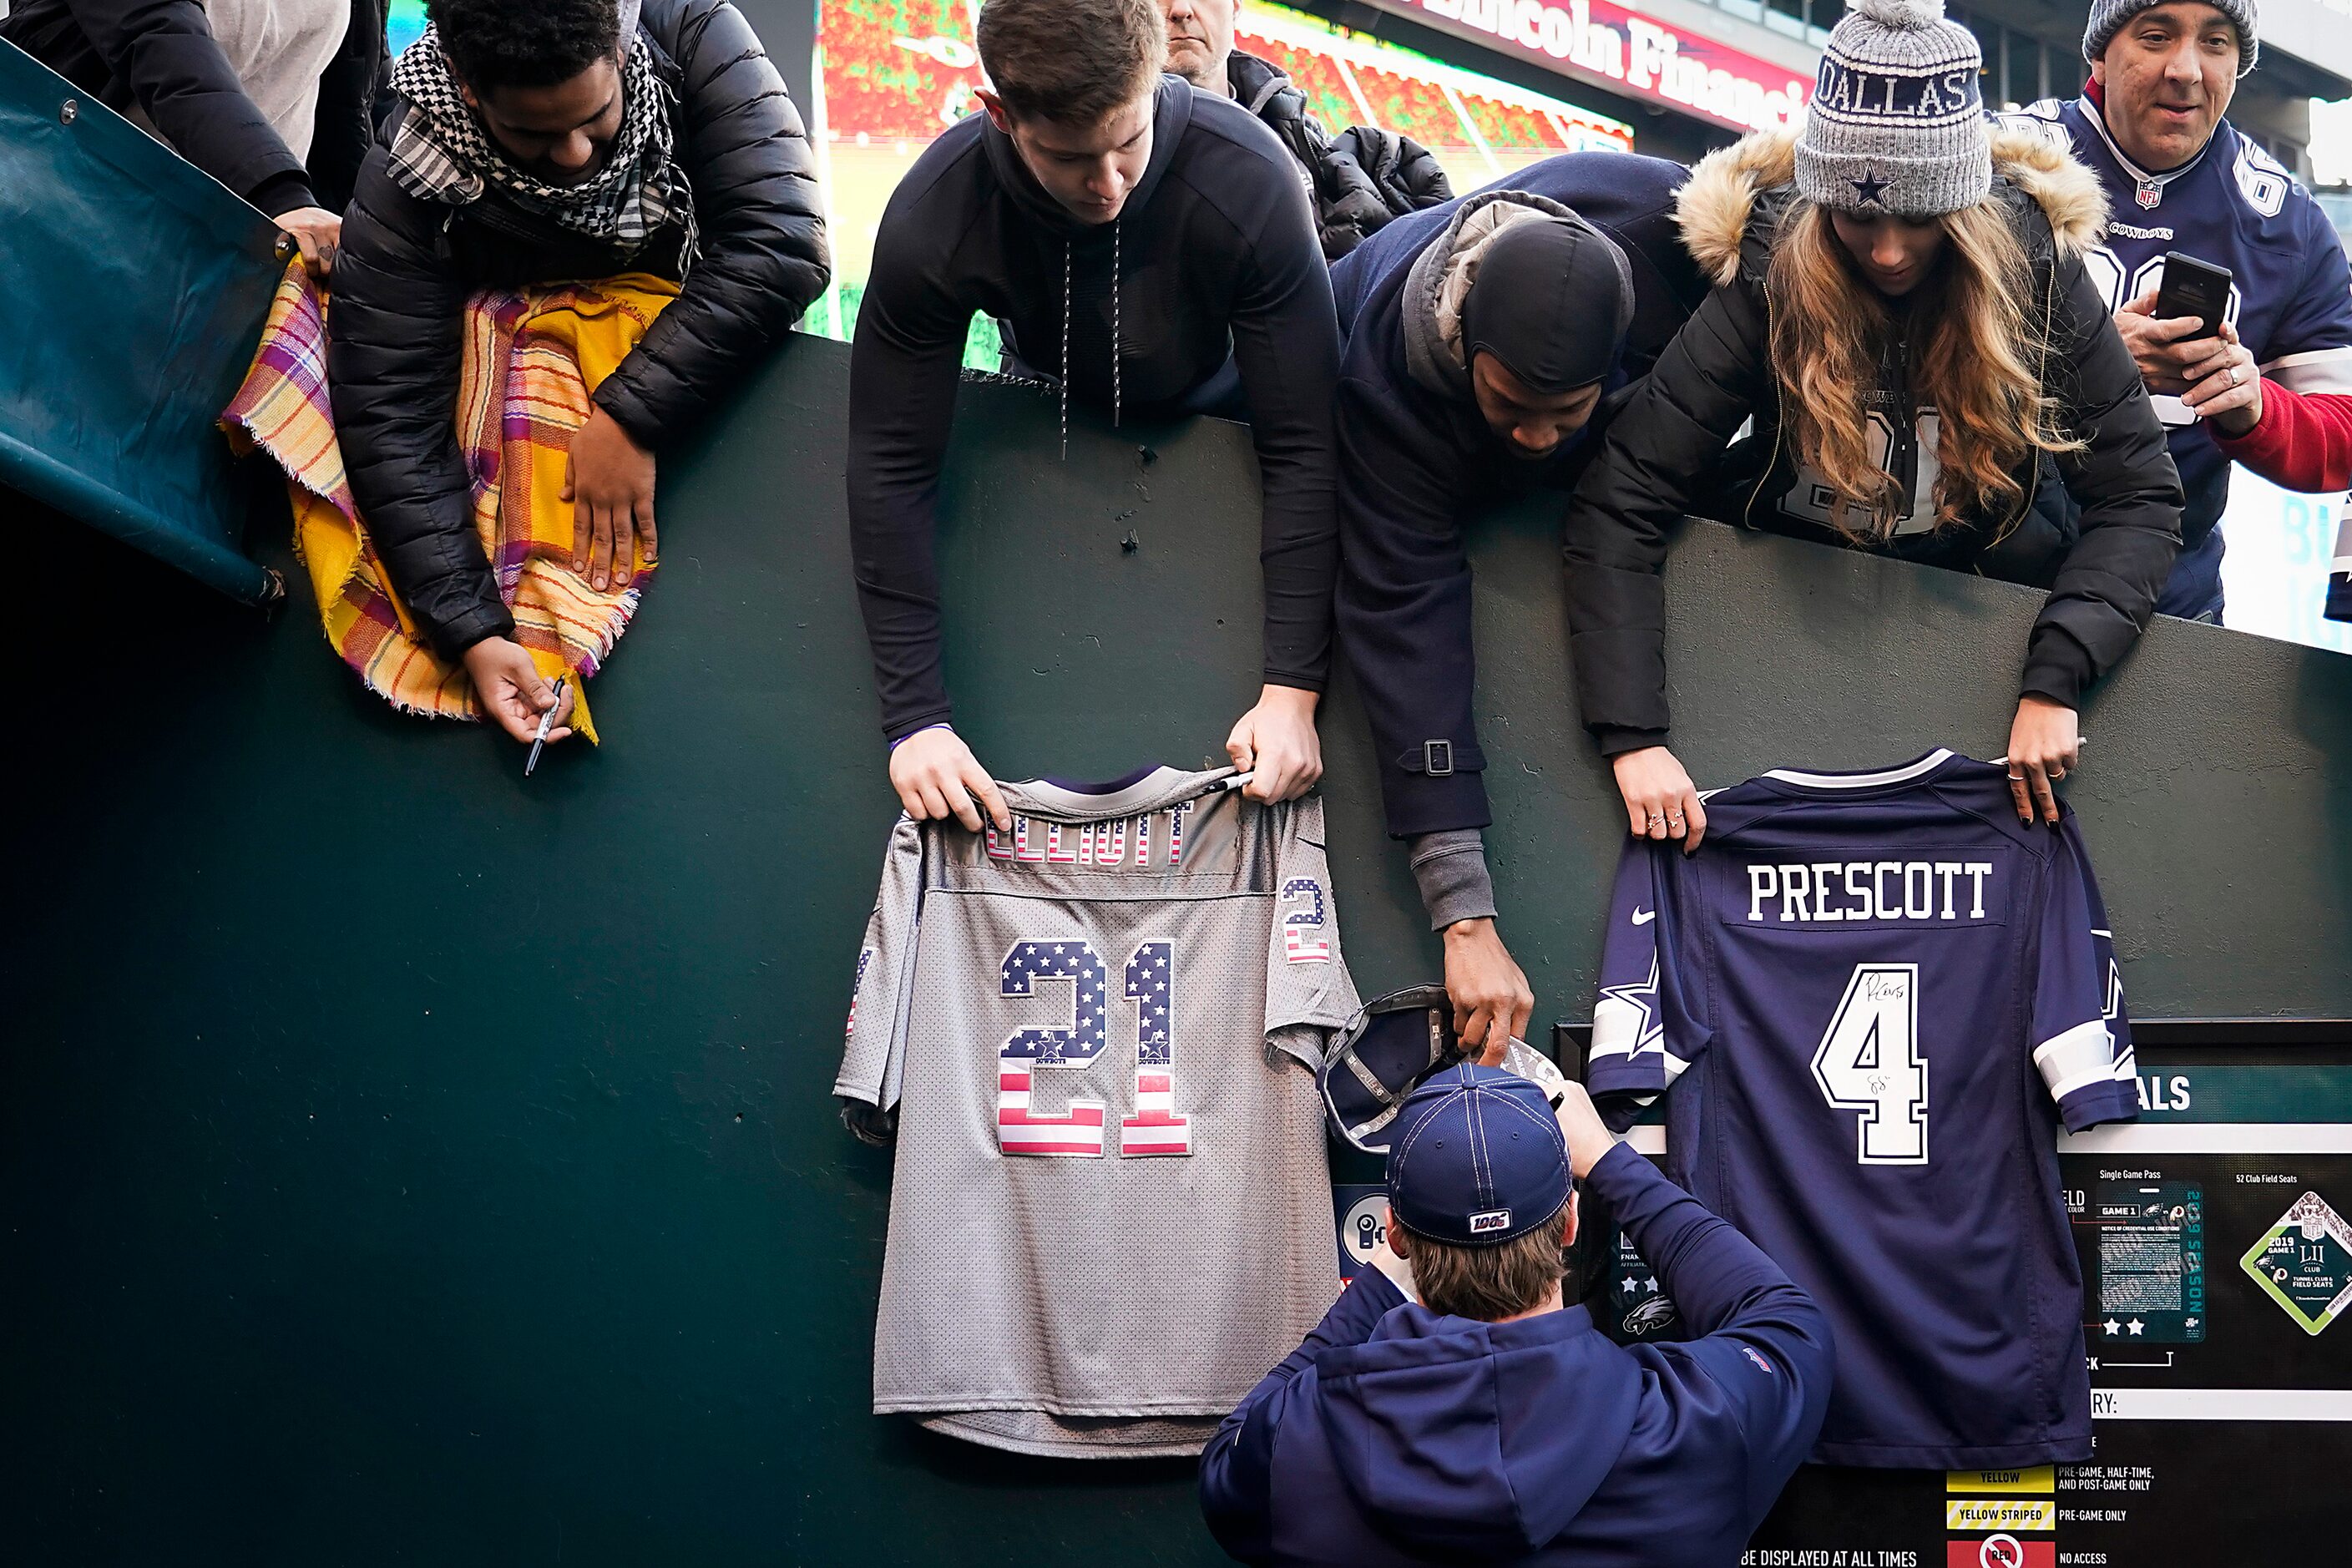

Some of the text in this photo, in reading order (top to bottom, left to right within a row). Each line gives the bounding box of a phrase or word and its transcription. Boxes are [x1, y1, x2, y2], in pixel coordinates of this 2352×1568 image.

[1818, 60, 1967, 117] DALLAS
[2139, 190, 2159, 205] NFL
[2109, 221, 2174, 240] COWBOYS
[1748, 862, 1993, 922] PRESCOTT
[999, 938, 1193, 1158] 21
[1810, 962, 1929, 1166] 4
[2100, 1169, 2161, 1181] Single Game Pass
[2236, 1174, 2298, 1183] 52 Club Field Seats
[2102, 1207, 2137, 1216] GAME 1
[2269, 1237, 2294, 1247] 2019
[2299, 1245, 2324, 1264] LII
[2092, 1393, 2117, 1414] RY:
[1980, 1472, 2020, 1483] YELLOW
[2059, 1467, 2154, 1479] PRE-GAME, HALF-TIME,
[2059, 1479, 2150, 1490] AND POST-GAME ONLY
[1960, 1510, 2042, 1520] YELLOW STRIPED
[2059, 1510, 2127, 1521] PRE-GAME ONLY
[1741, 1550, 1917, 1567] BE DISPLAYED AT ALL TIMES
[1991, 1550, 2011, 1560] RED
[2060, 1553, 2107, 1564] NO ACCESS
